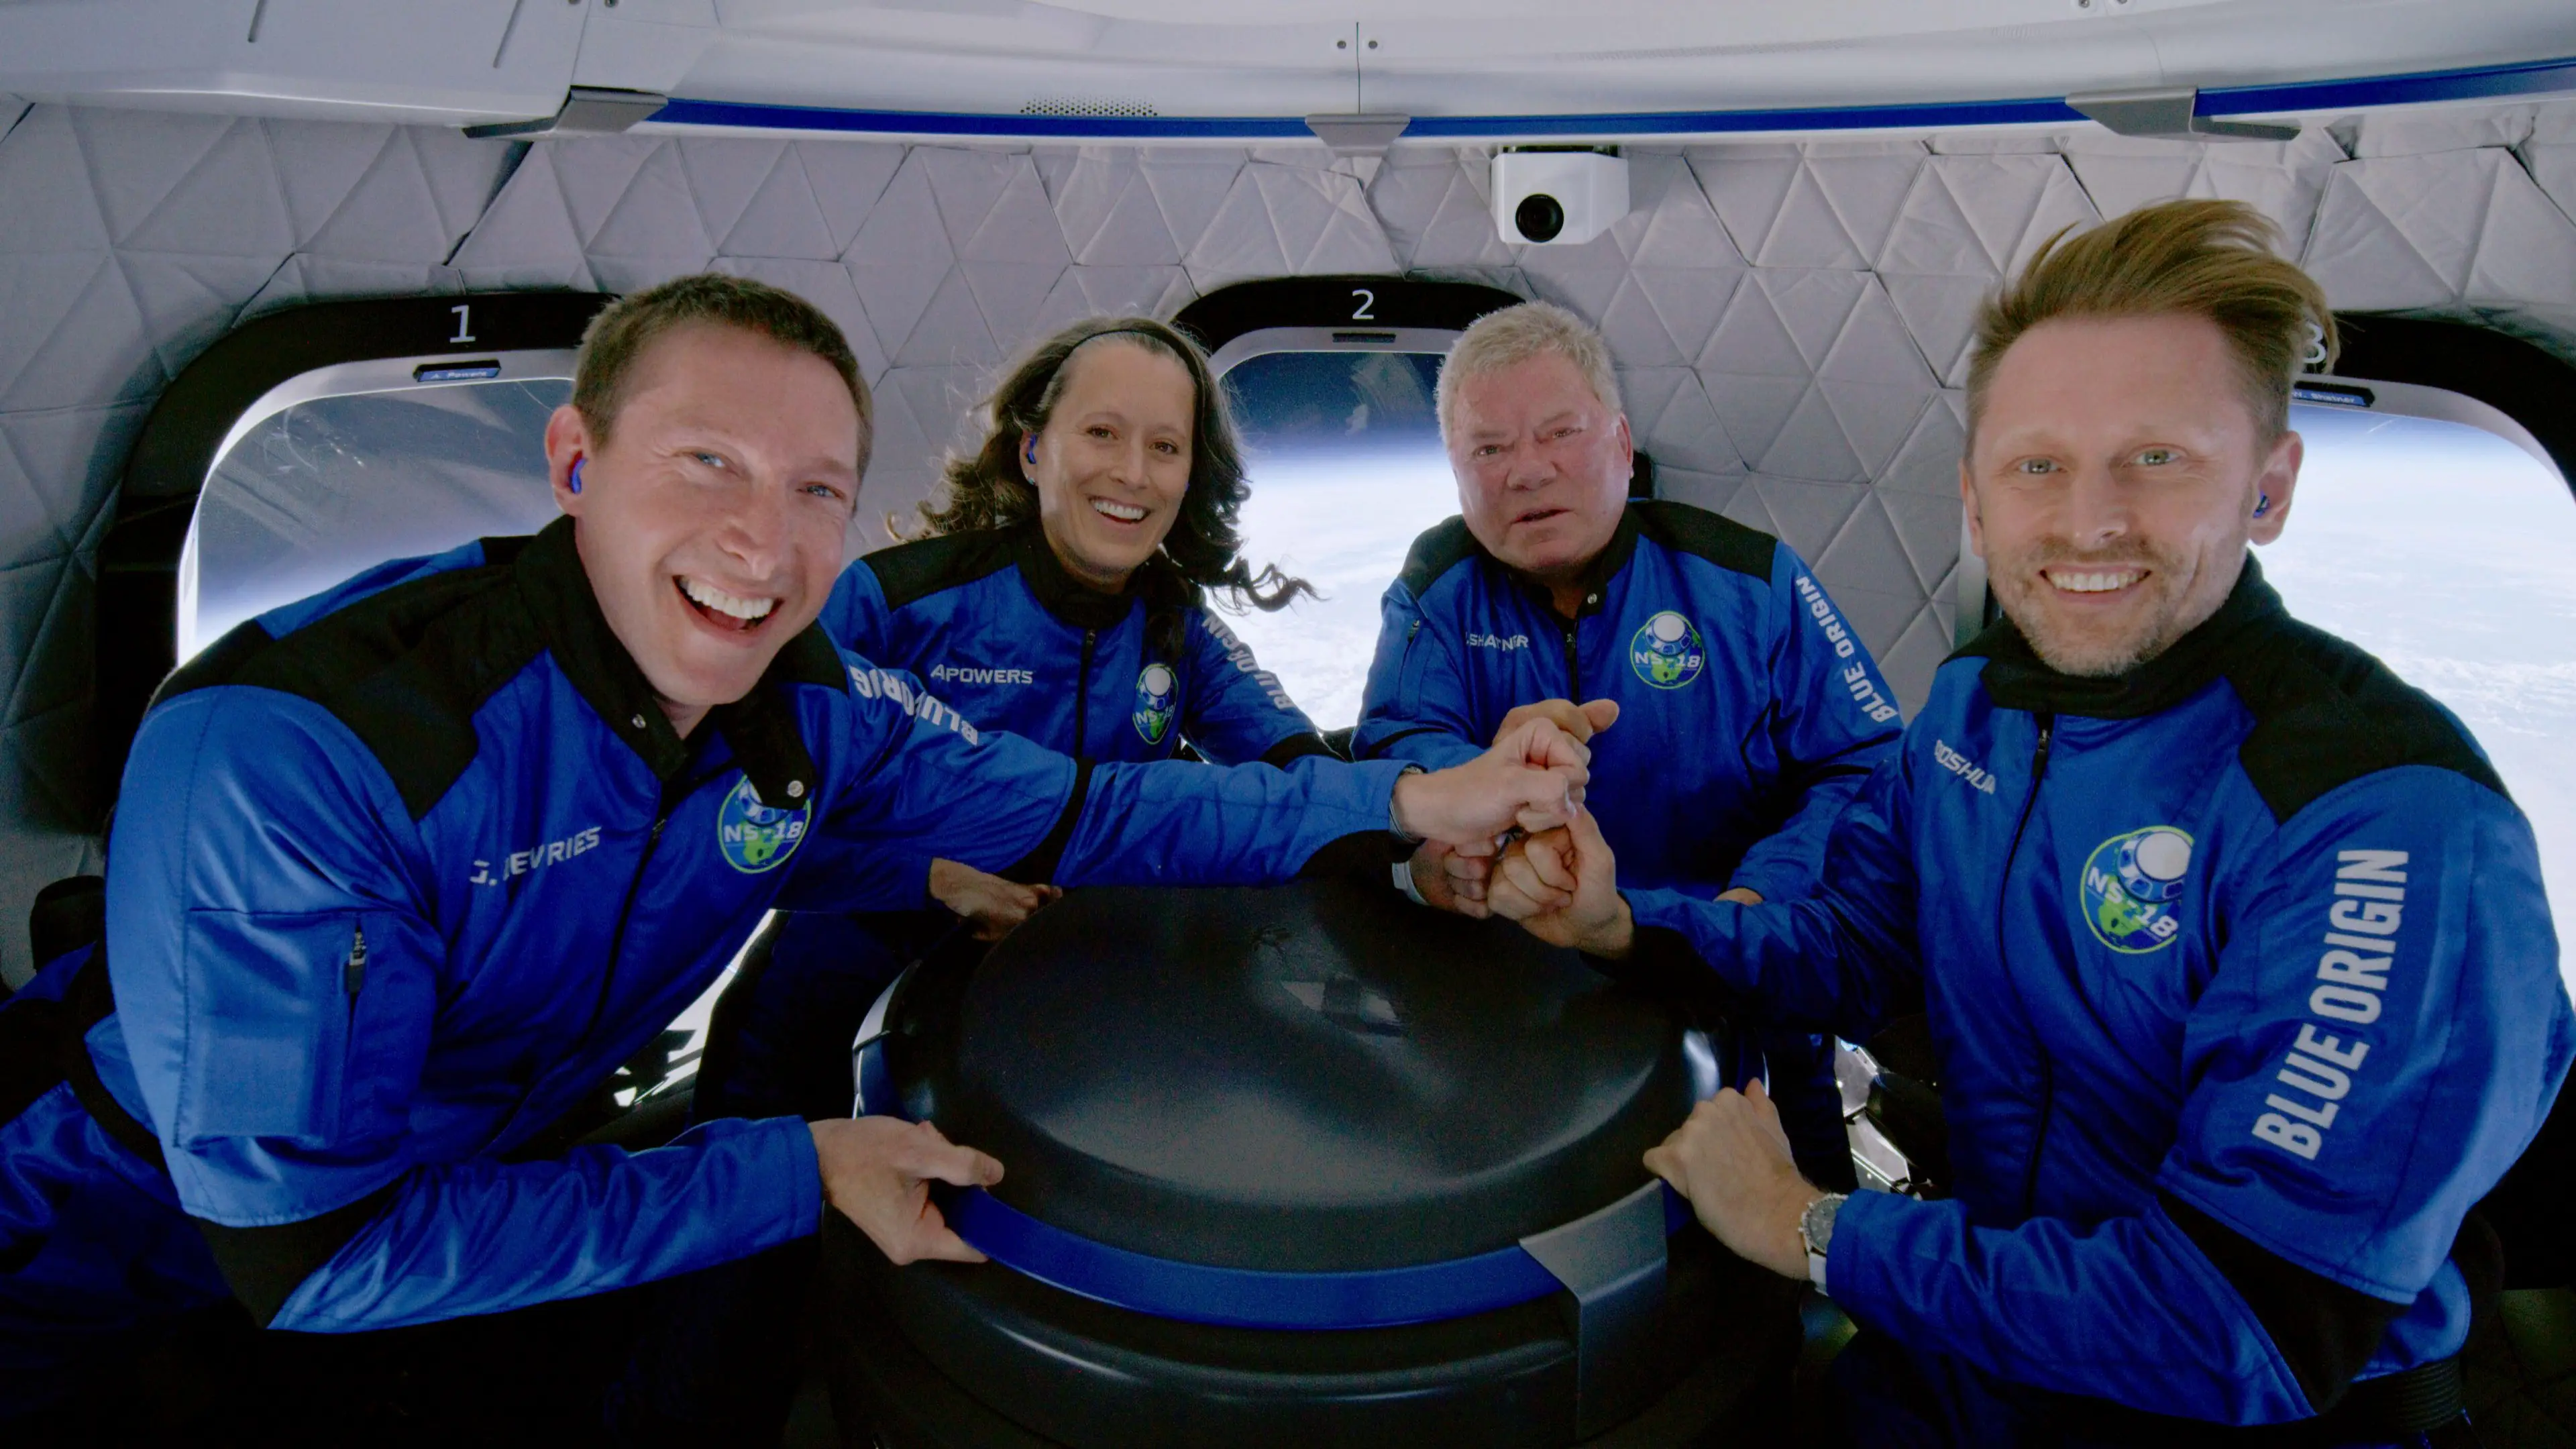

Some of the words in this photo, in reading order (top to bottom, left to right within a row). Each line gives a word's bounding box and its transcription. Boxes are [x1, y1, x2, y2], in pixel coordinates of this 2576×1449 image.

[449, 304, 476, 343] 1
[1352, 288, 1375, 320] 2
[2302, 321, 2327, 364] 3
[1795, 576, 1856, 659] ORIGIN
[1634, 651, 1701, 669] NS-18
[1843, 661, 1899, 722] BLUE
[723, 820, 805, 843] NS-18
[2087, 866, 2180, 938] NS-18
[2309, 849, 2410, 1025] ORIGIN
[2251, 1022, 2371, 1161] BLUE
